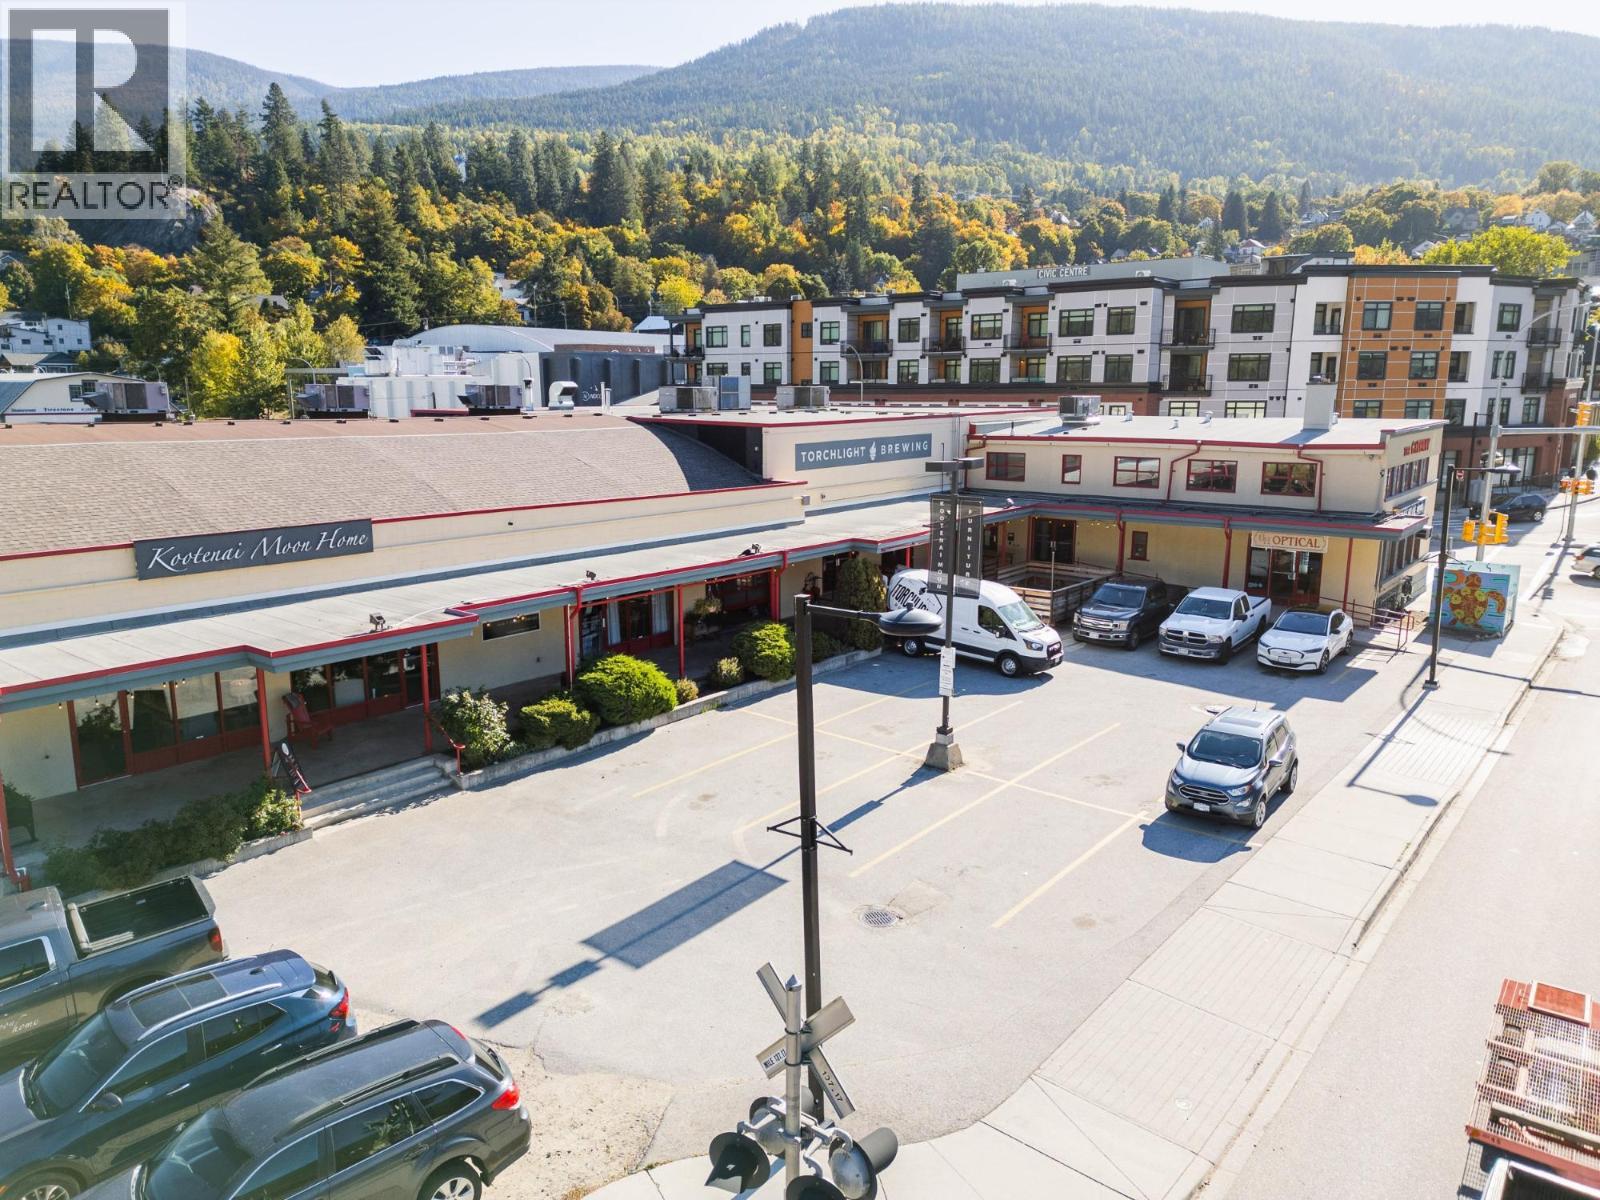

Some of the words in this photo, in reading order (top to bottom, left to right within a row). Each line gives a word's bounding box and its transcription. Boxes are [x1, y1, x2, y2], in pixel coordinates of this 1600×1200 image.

[1038, 269, 1056, 279] CIVIC
[1060, 266, 1088, 277] CENTRE
[801, 446, 866, 463] TORCHLIGHT
[880, 441, 929, 455] BREWING
[148, 542, 245, 573] Kootenai
[250, 536, 312, 560] Moon
[315, 527, 369, 551] Home
[1272, 535, 1320, 548] OPTICAL
